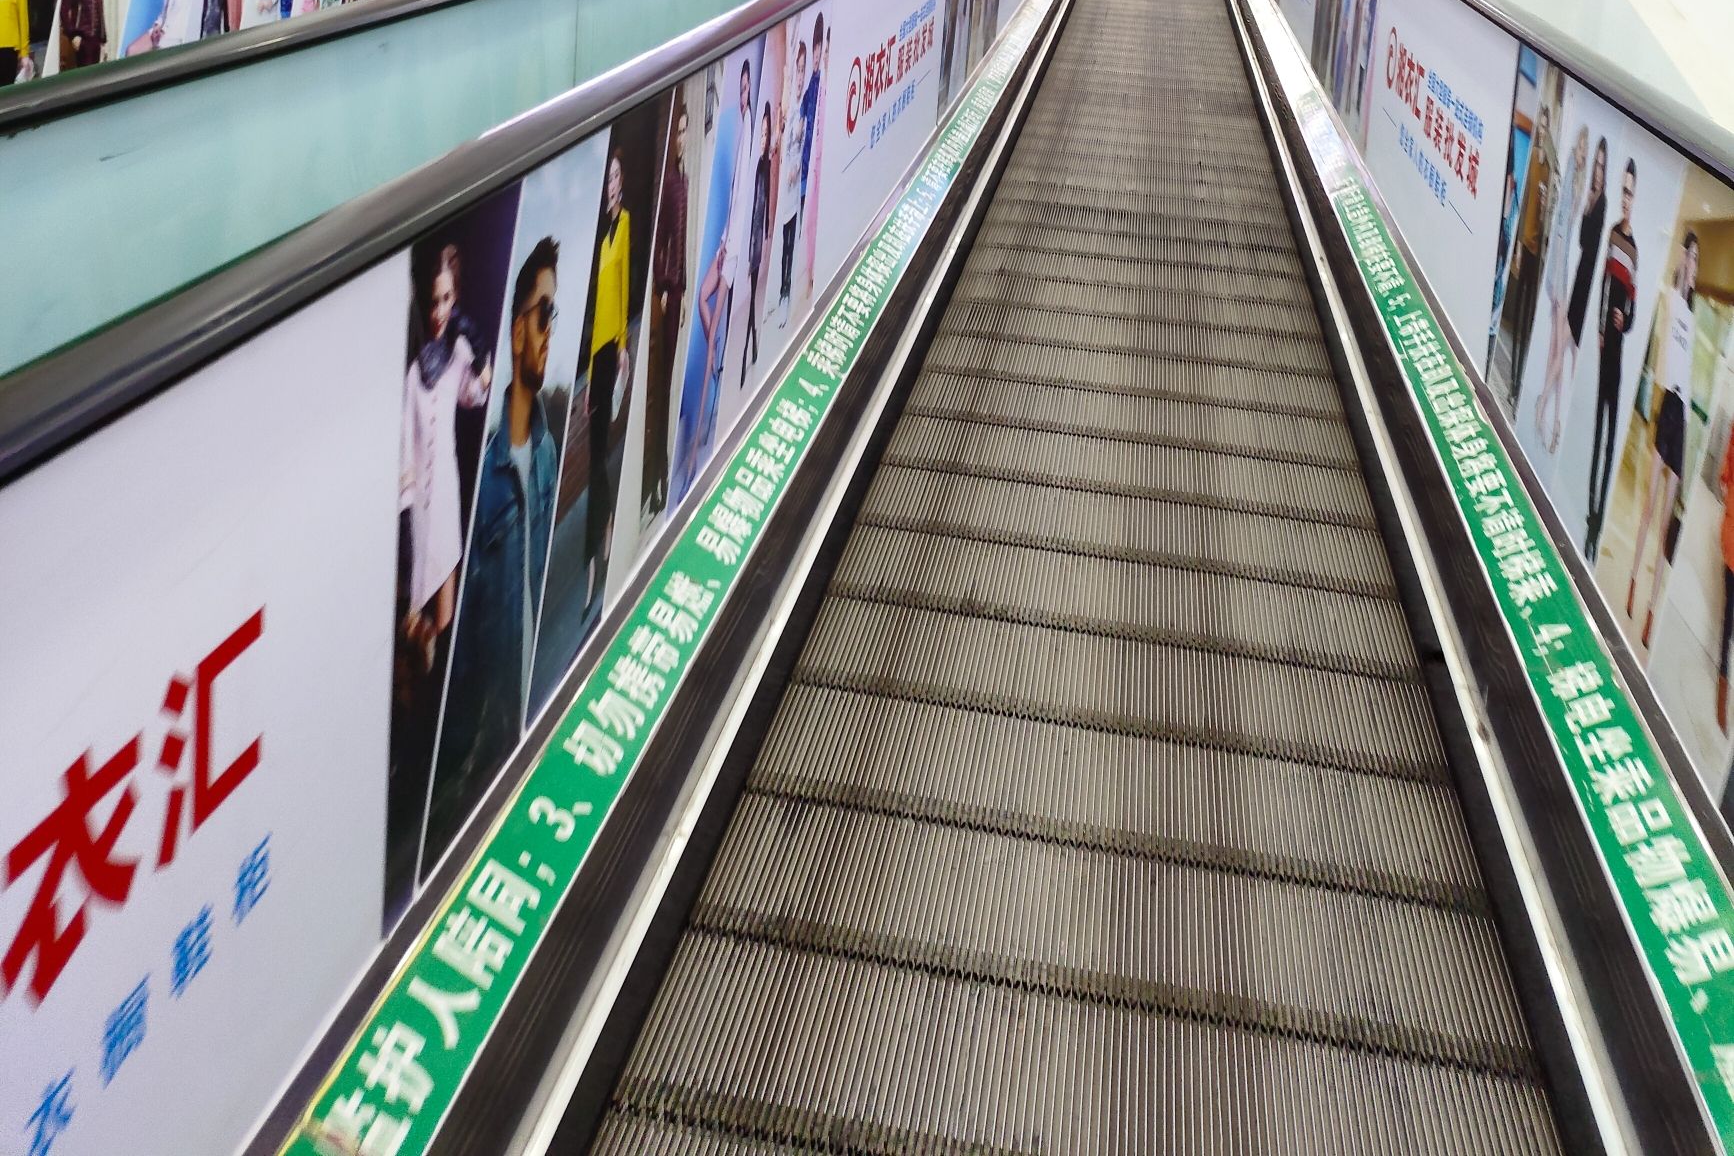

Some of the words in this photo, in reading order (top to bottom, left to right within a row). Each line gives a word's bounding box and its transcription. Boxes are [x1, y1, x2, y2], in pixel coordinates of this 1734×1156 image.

[862, 34, 897, 117] 湘衣汇
[896, 16, 935, 85] 服装批发城
[1394, 42, 1426, 122] 湘衣汇
[1422, 94, 1480, 200] 服装批发城
